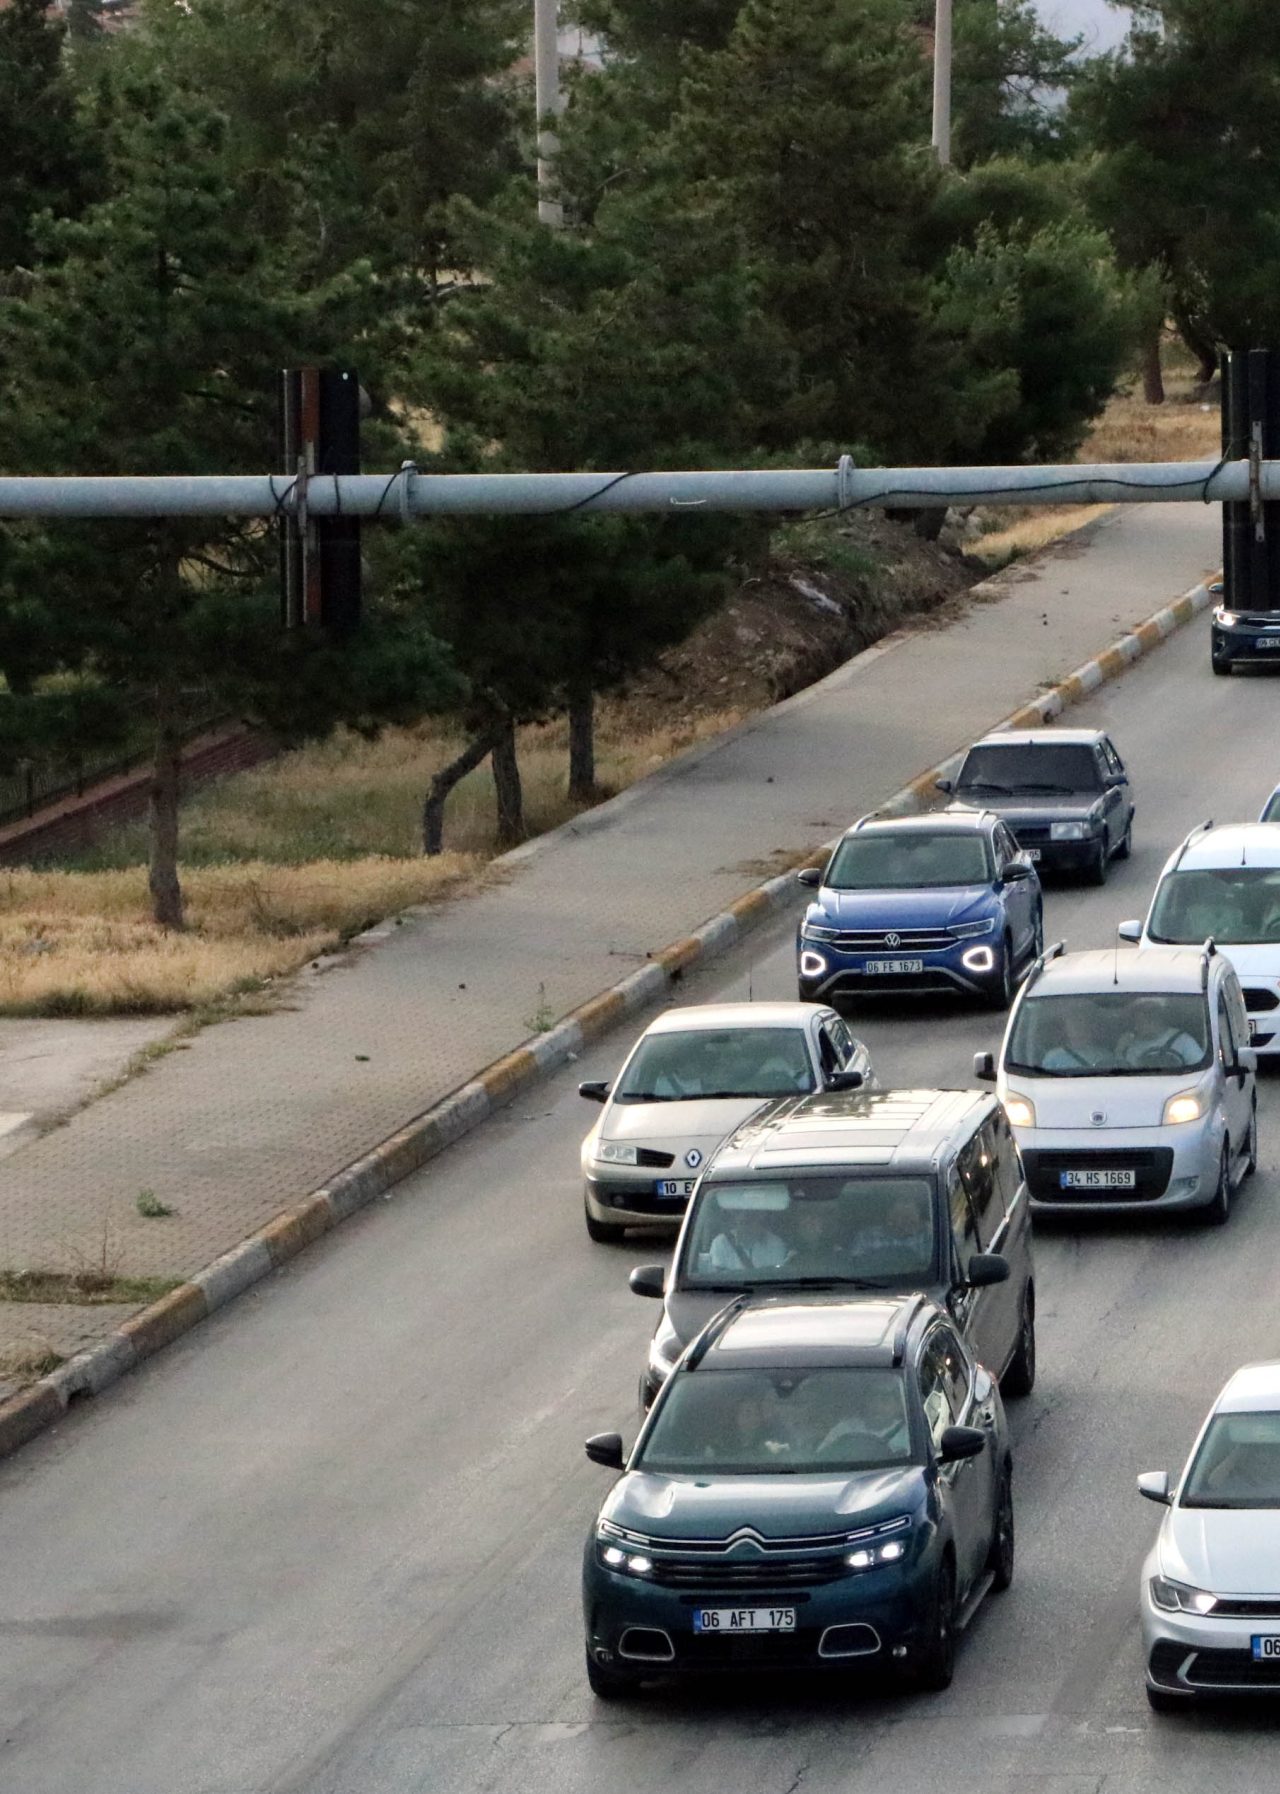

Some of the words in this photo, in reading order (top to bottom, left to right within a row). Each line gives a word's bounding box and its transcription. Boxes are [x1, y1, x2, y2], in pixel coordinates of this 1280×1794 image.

[867, 962, 879, 973] 06
[883, 962, 894, 972] FE
[899, 961, 921, 972] 1673
[1068, 1172, 1081, 1184] 34
[1086, 1172, 1100, 1184] HS
[1104, 1172, 1131, 1184] 1669
[664, 1182, 677, 1194] 10
[702, 1611, 720, 1628] 06
[730, 1610, 756, 1627] AFT
[769, 1609, 794, 1627] 175
